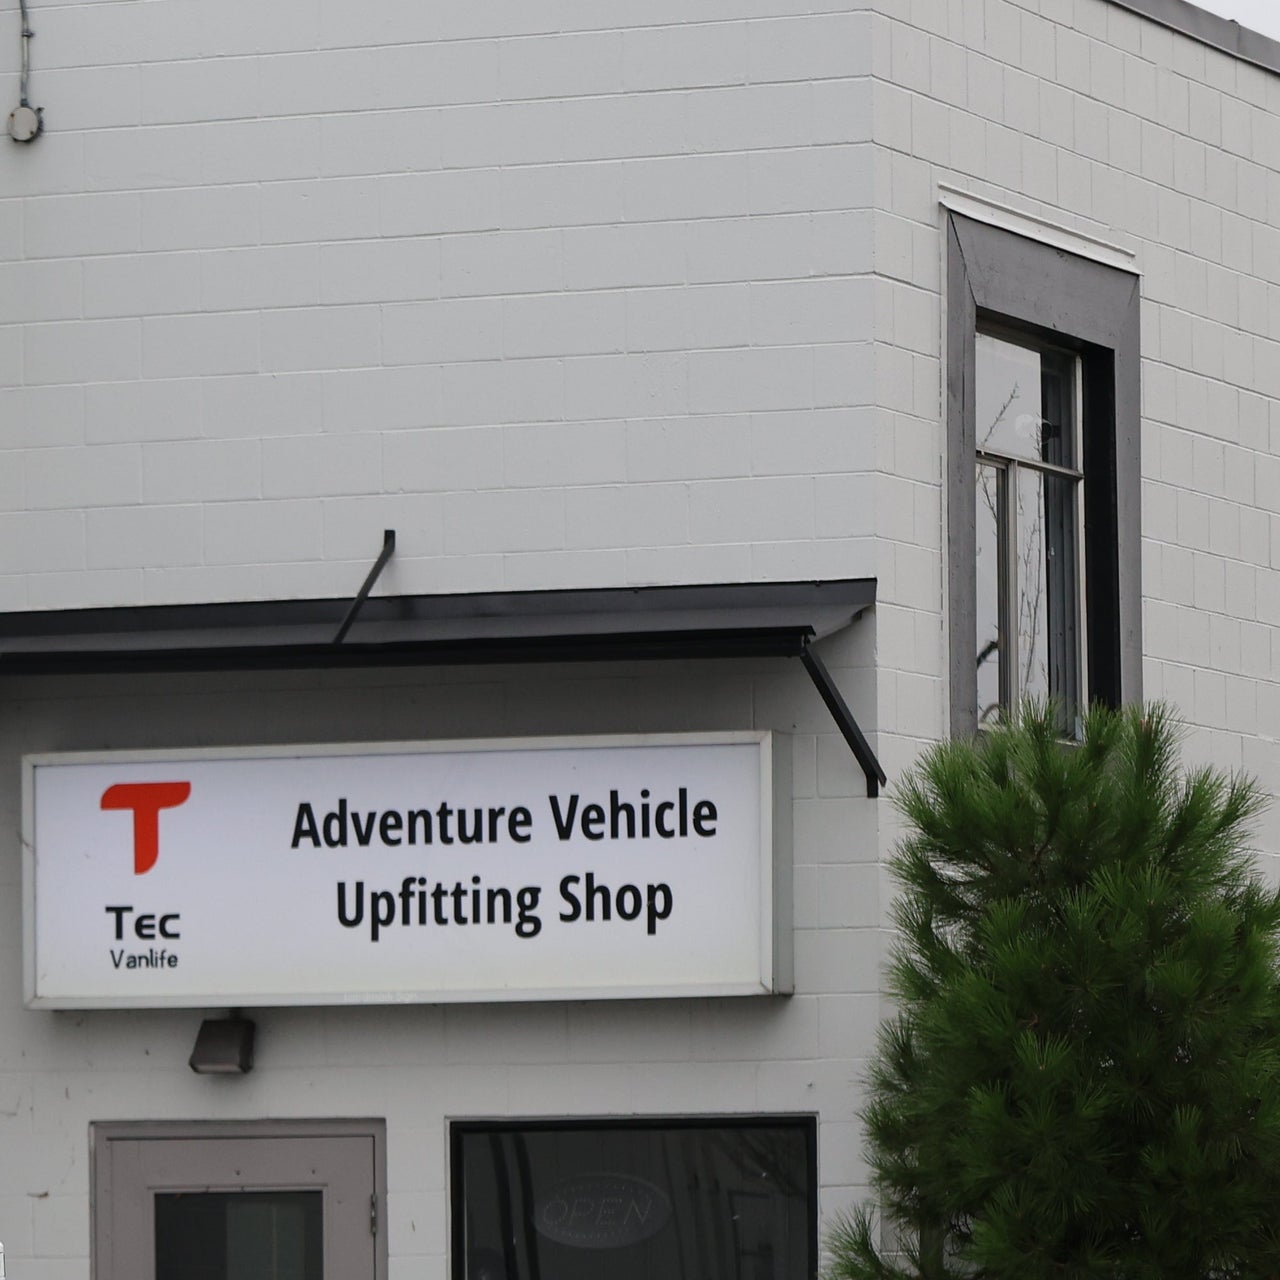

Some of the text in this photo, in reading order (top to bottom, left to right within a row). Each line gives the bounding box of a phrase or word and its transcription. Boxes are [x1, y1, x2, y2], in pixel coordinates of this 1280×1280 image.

[100, 781, 191, 874] T
[291, 788, 718, 849] Adventure Vehicle
[337, 872, 673, 943] Upfitting Shop
[110, 948, 179, 970] Vanlife
[543, 1196, 653, 1226] OPEN
